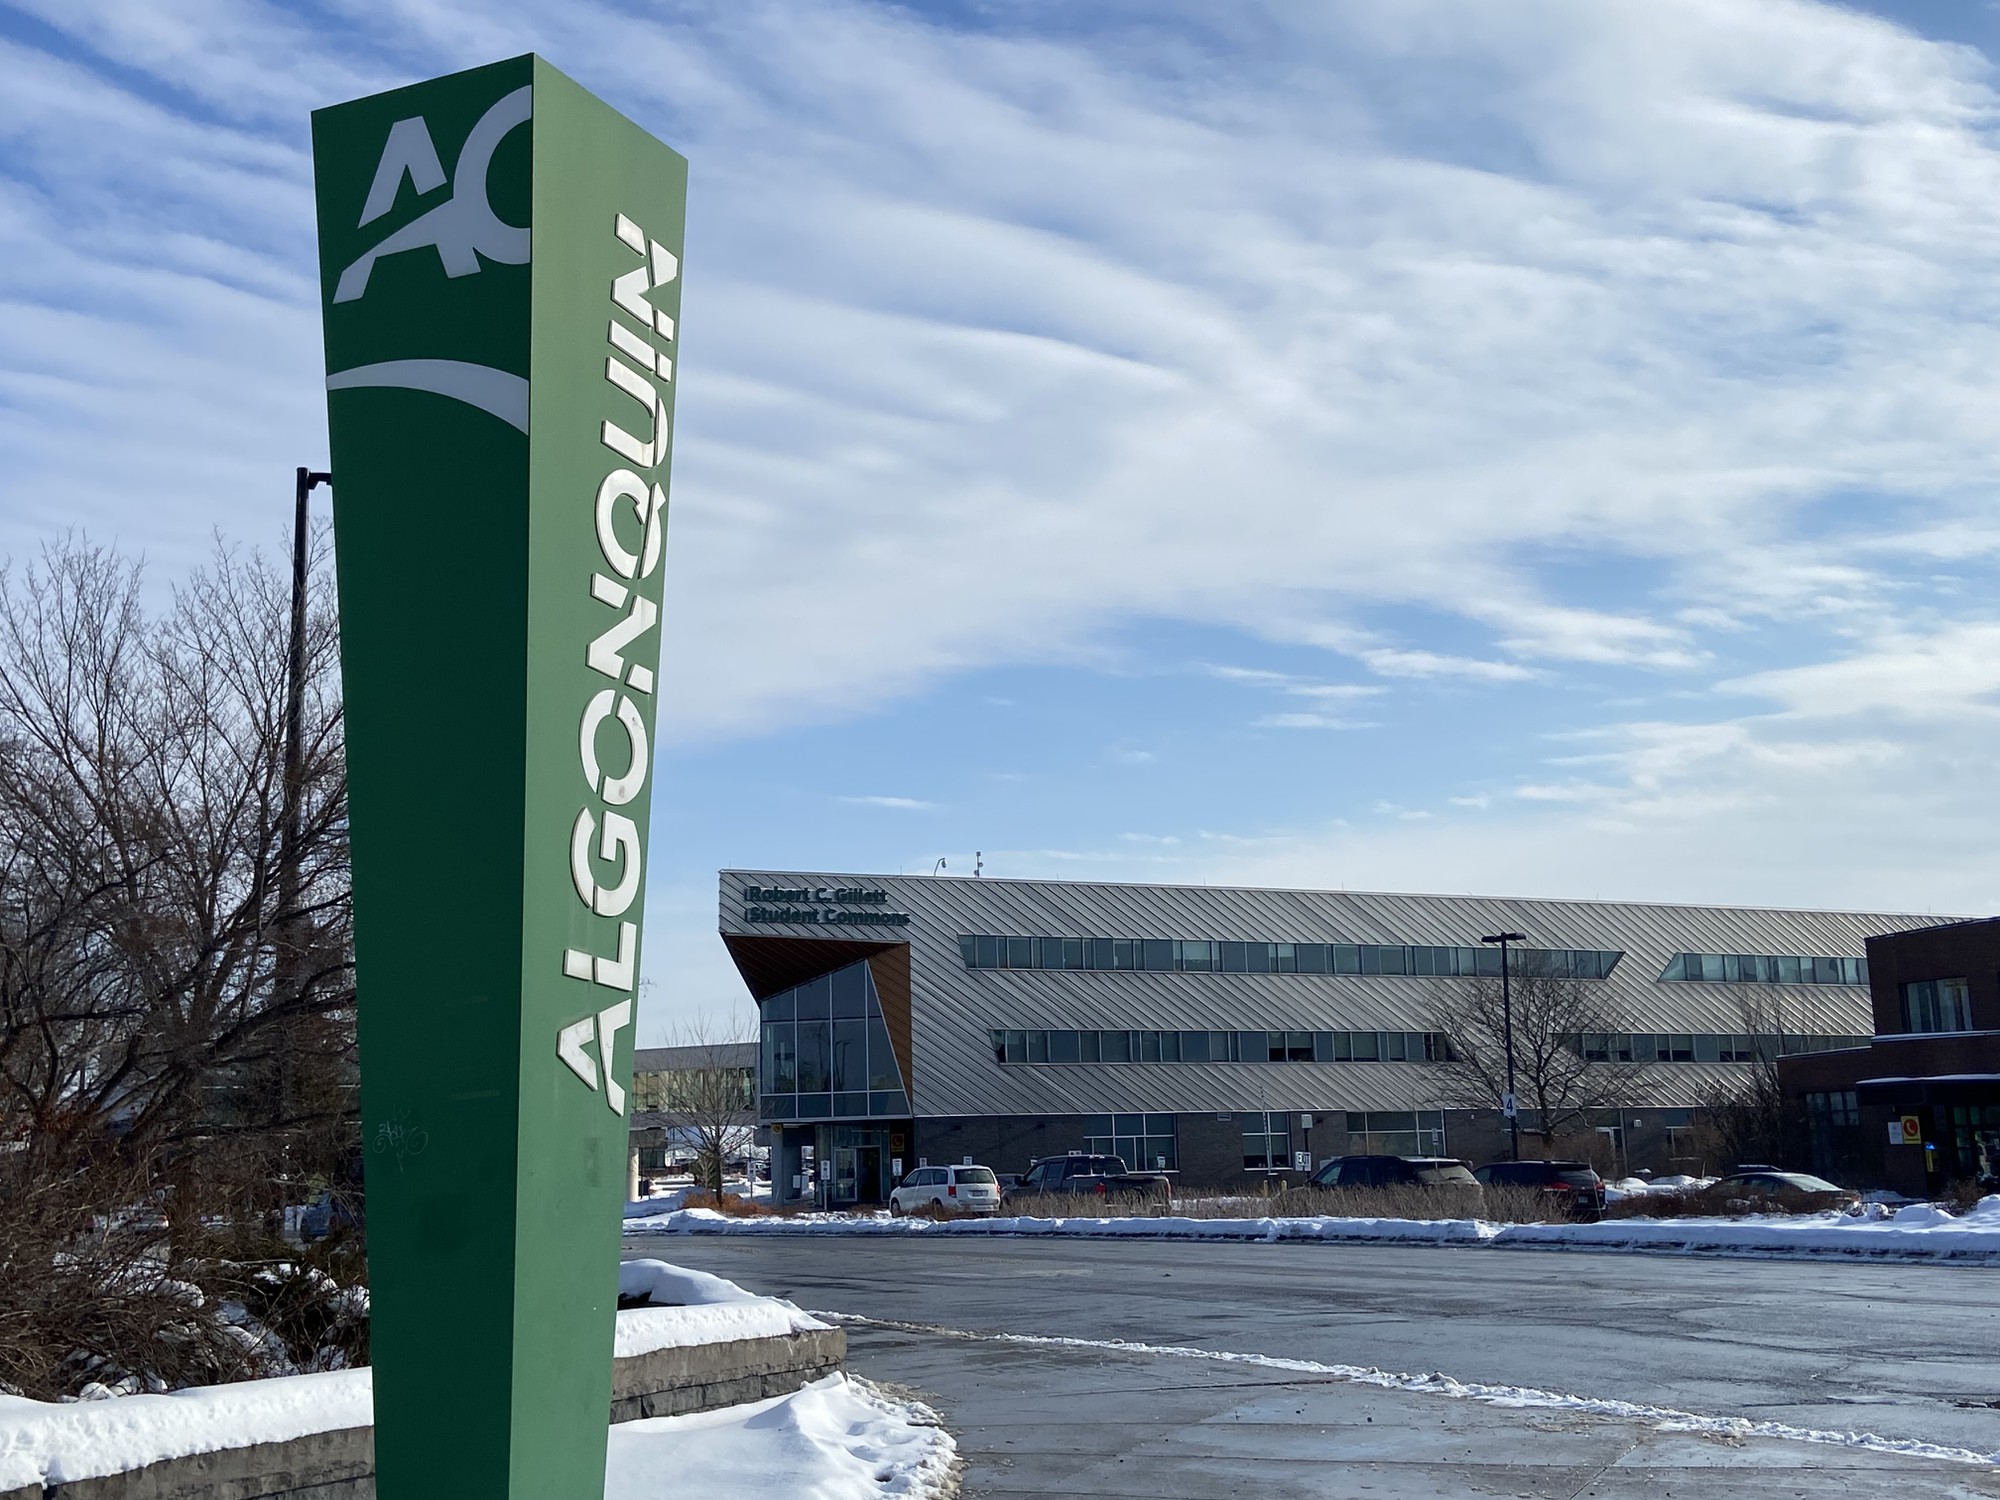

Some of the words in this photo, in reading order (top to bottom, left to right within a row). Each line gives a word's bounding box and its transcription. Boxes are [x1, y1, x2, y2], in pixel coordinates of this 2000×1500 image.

[557, 212, 678, 1117] ALGONQUIN
[746, 884, 810, 901] Robert
[815, 887, 832, 901] C.
[834, 888, 888, 903] Gillett
[745, 906, 819, 923] Student
[824, 909, 911, 925] Commons
[1507, 1098, 1513, 1112] 4
